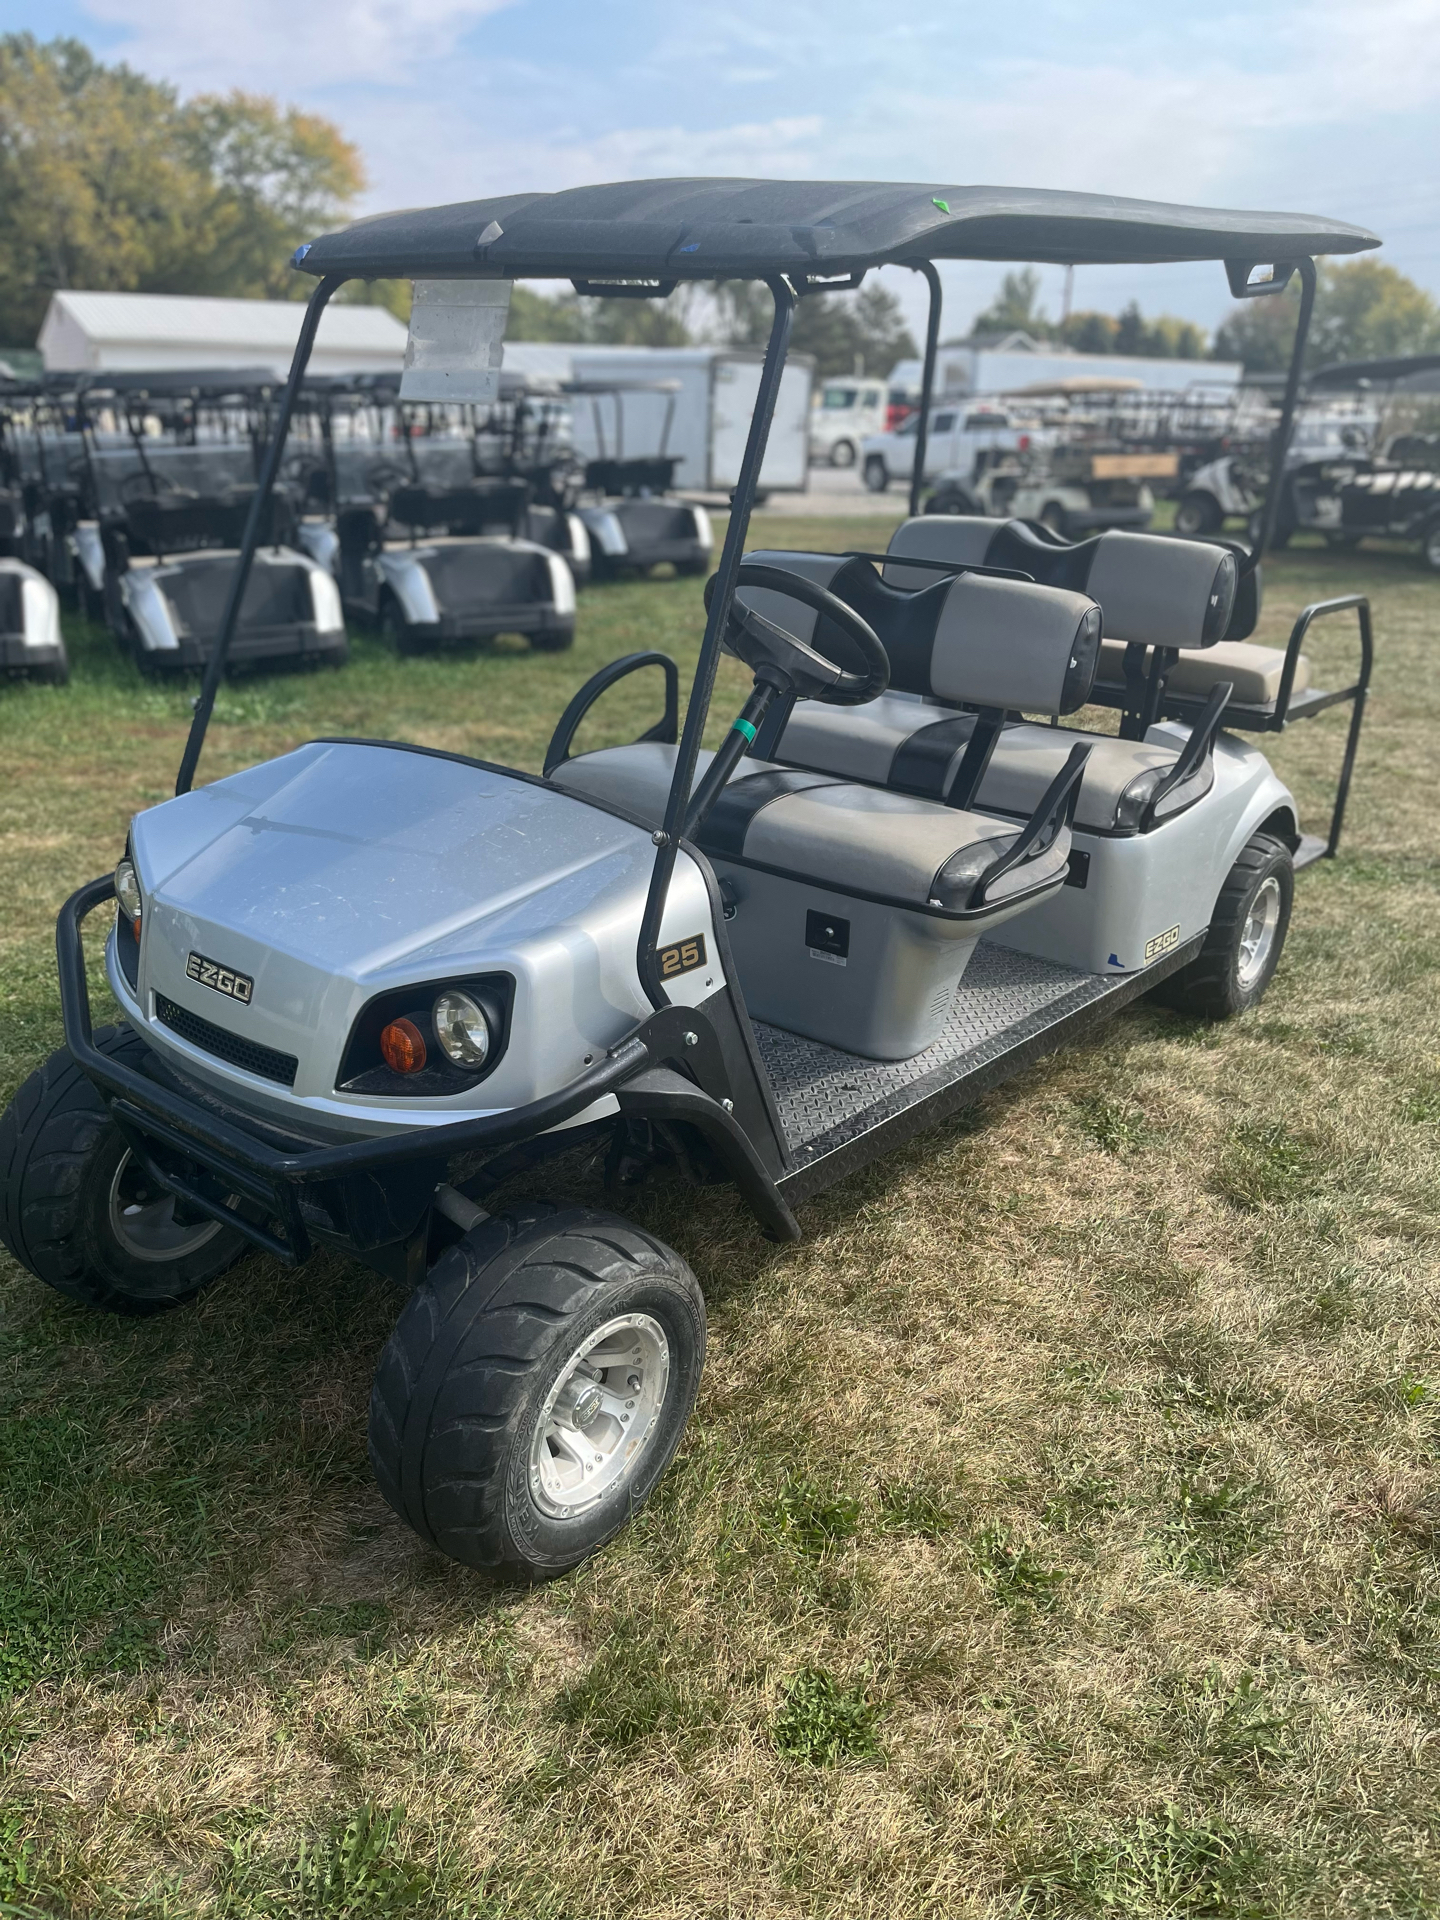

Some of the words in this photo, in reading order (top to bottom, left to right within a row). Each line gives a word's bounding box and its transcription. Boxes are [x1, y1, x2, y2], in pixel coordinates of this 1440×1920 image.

[187, 954, 252, 1001] EZGO
[661, 942, 699, 974] 25
[515, 1444, 540, 1543] KENDA
